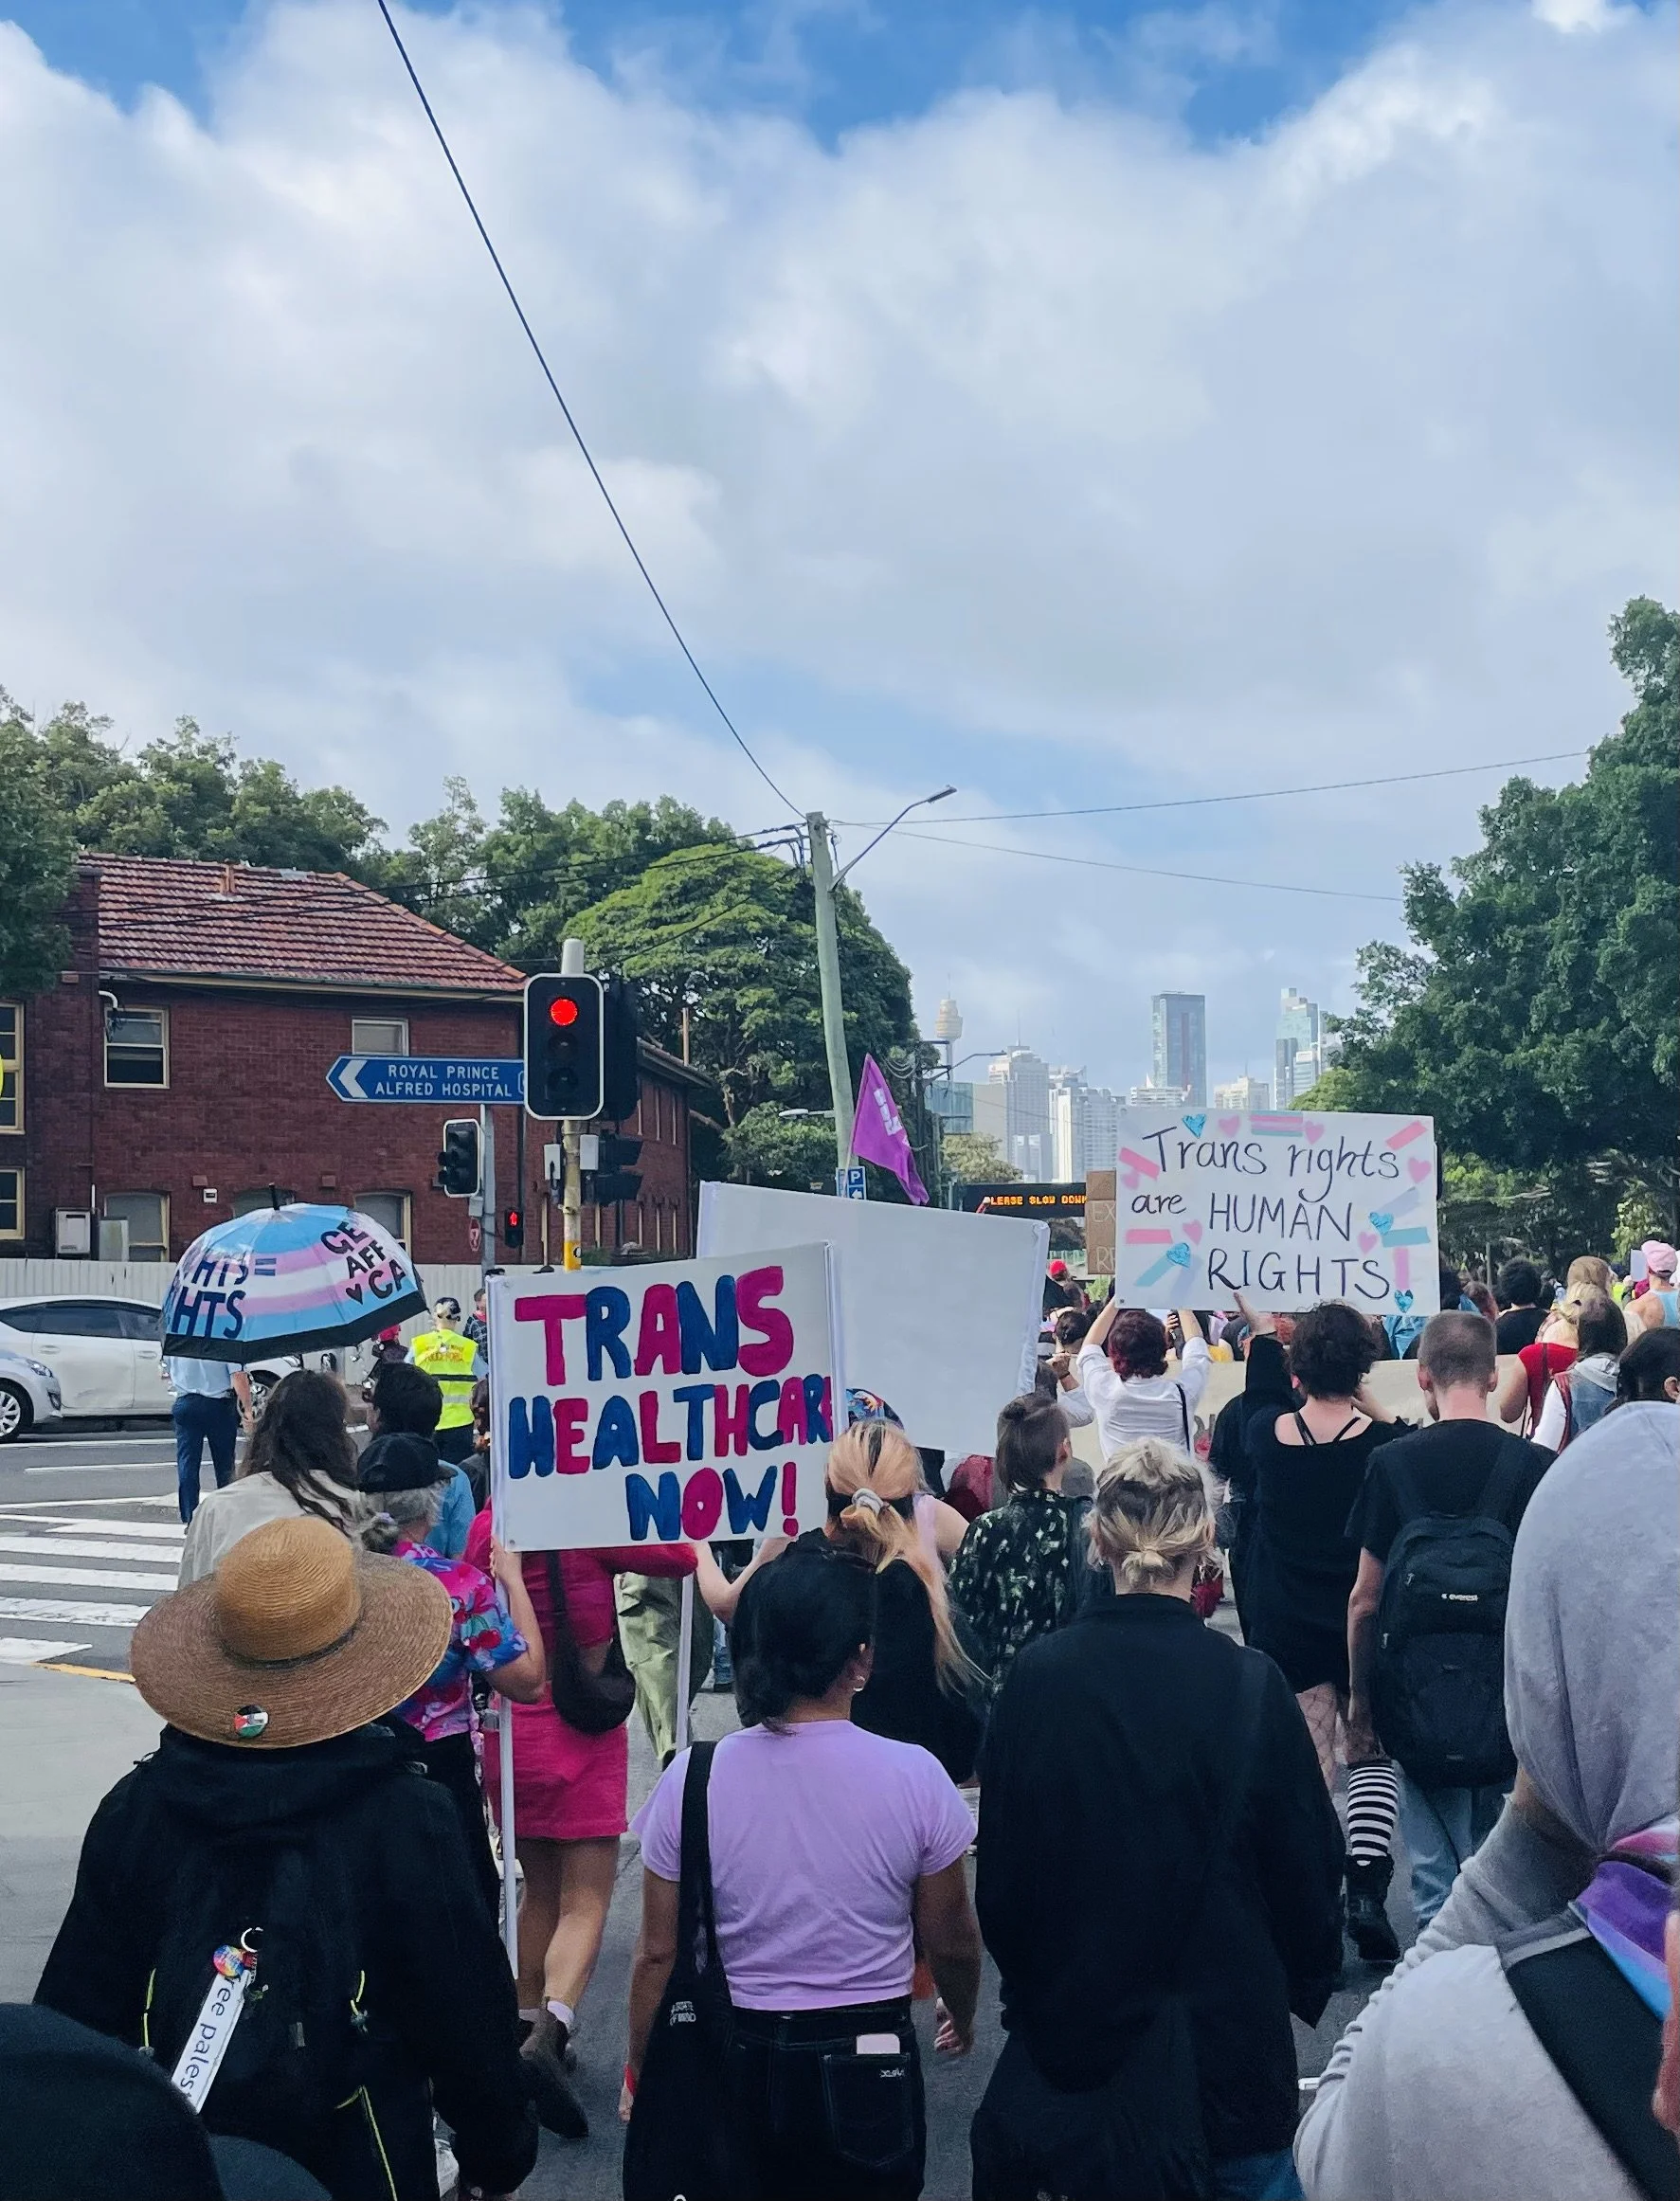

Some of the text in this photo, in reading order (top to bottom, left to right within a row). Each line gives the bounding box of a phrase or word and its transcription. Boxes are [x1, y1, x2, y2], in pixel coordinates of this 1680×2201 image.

[375, 1082, 512, 1097] ALFRED HOSPITAL
[388, 1064, 499, 1079] ROYAL PRINCE
[850, 1171, 861, 1183] P
[1143, 1127, 1400, 1203] Trans rights
[1131, 1193, 1352, 1242] are HUMAN
[1208, 1248, 1390, 1300] RIGHTS
[515, 1266, 794, 1385] TRANS
[625, 1461, 799, 1542] NOW!
[180, 2023, 218, 2096] pales
